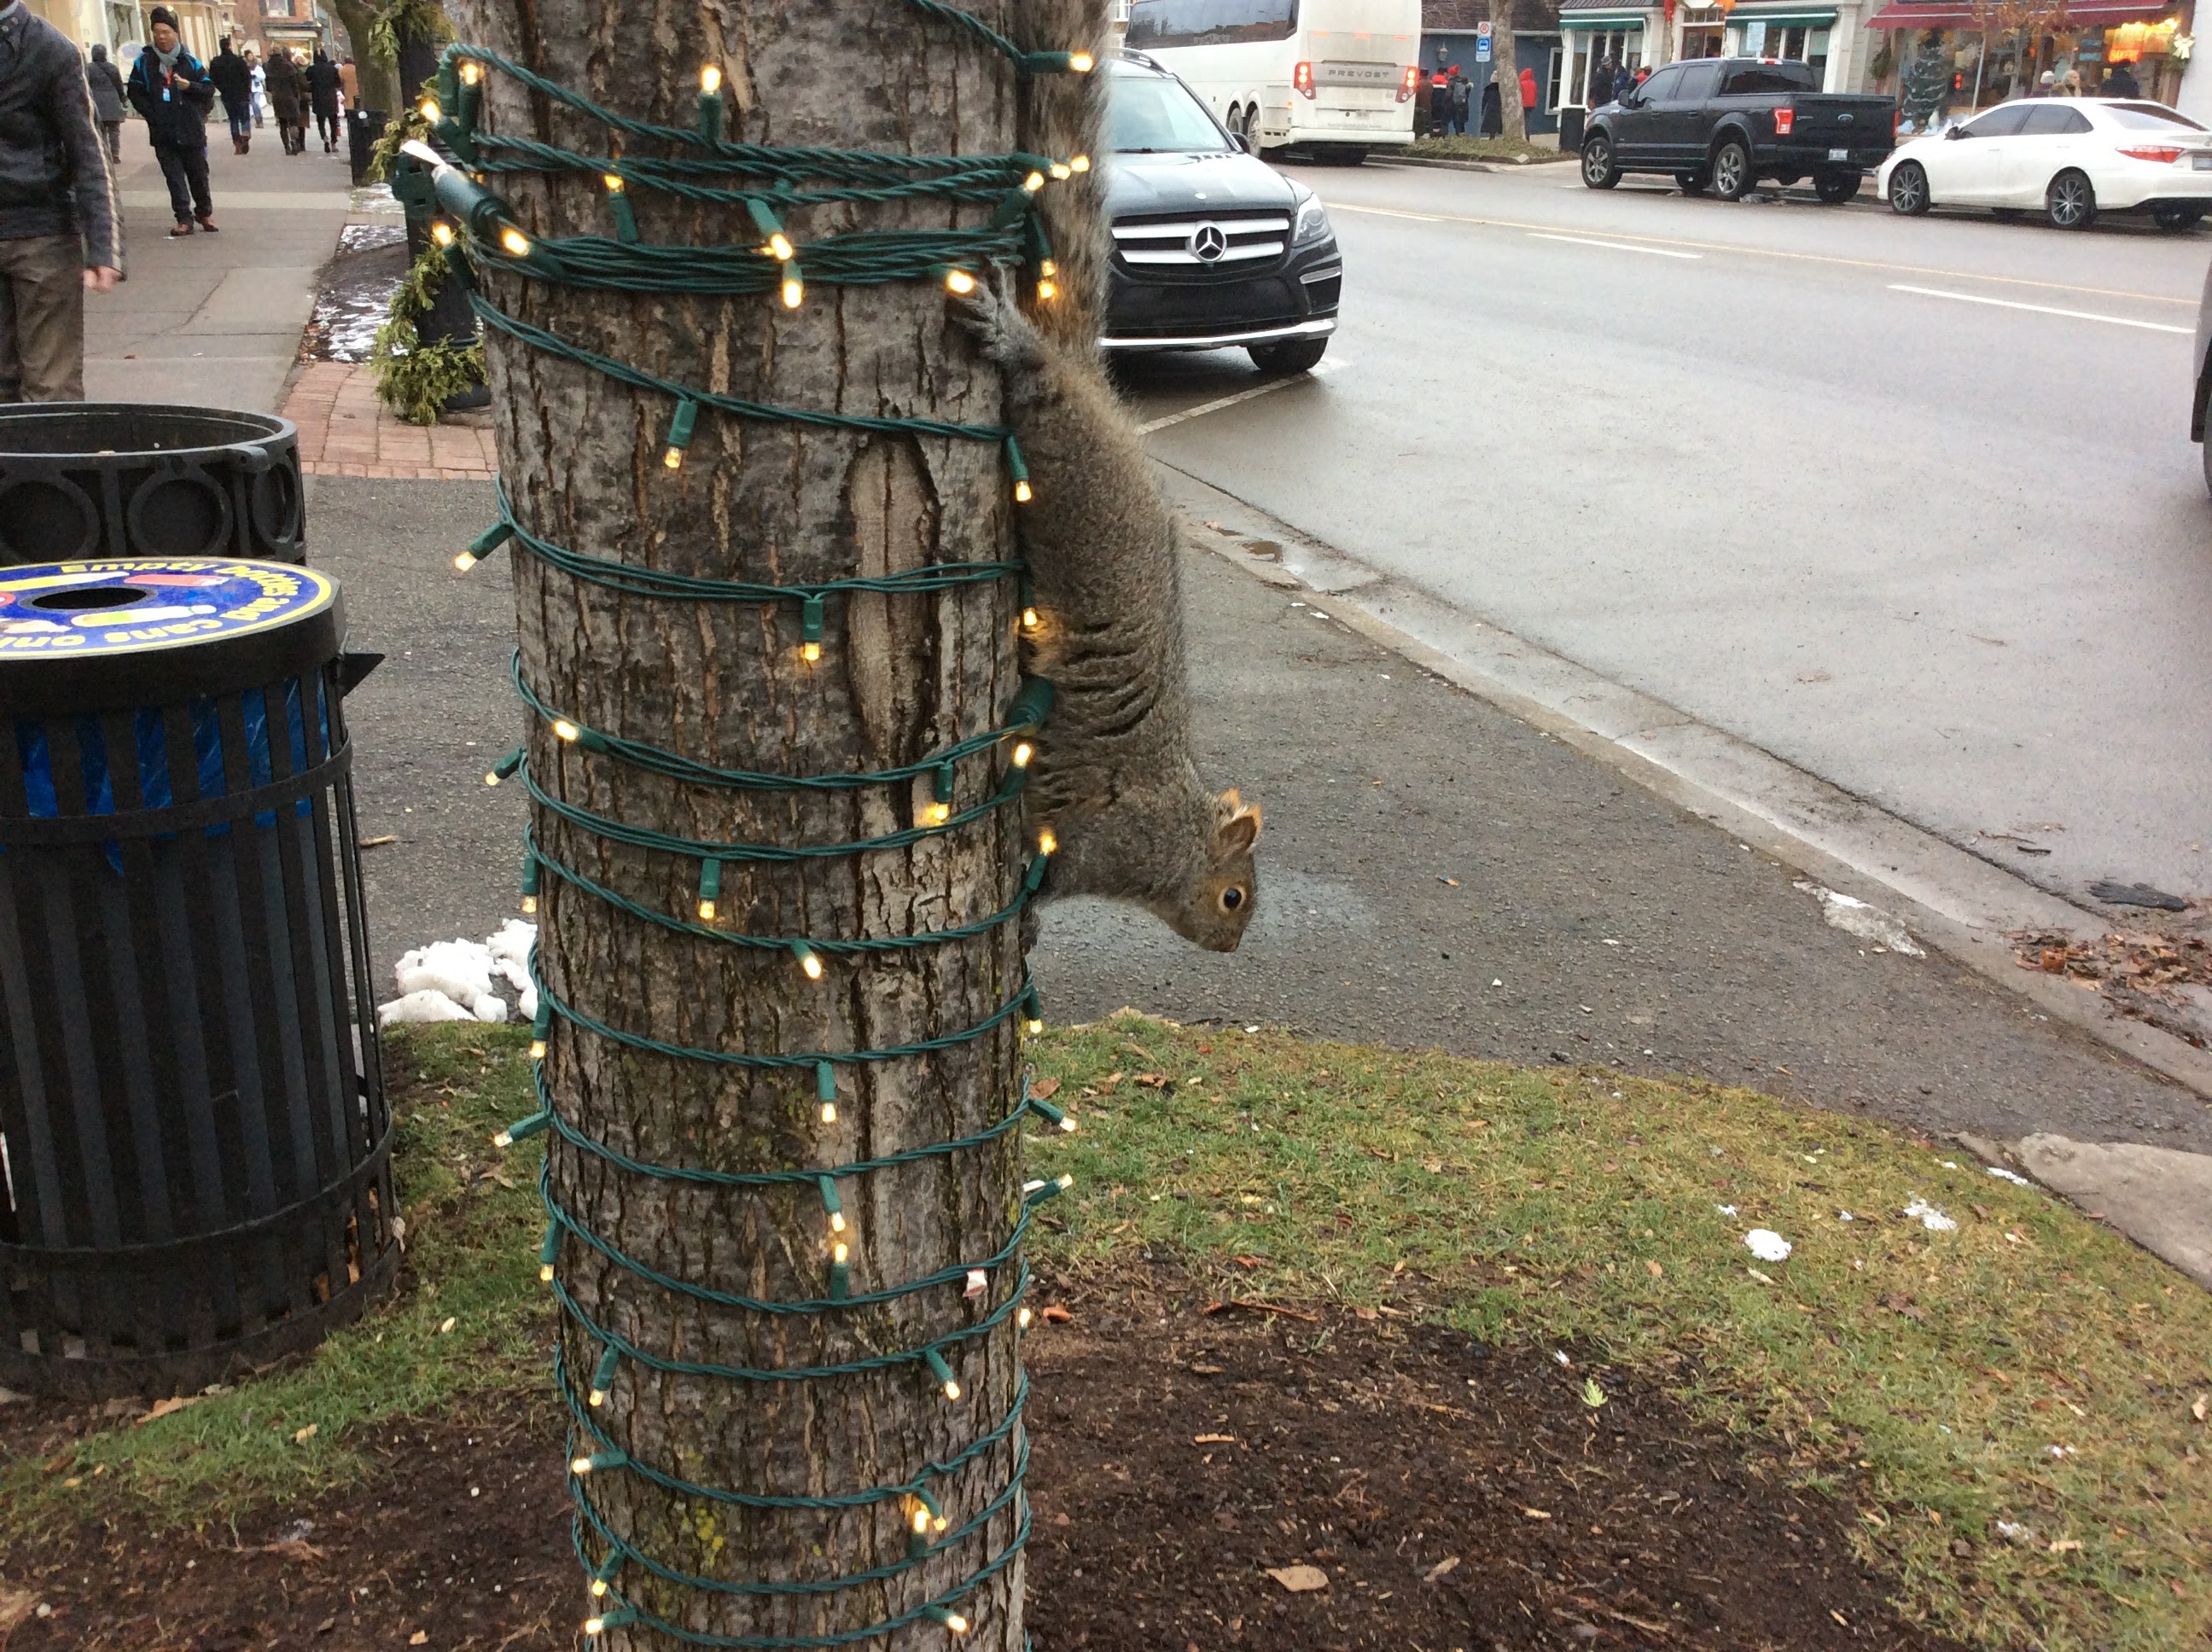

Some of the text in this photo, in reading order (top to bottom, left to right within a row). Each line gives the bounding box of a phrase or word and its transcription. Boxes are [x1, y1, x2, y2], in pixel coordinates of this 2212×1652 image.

[1329, 69, 1389, 78] PREVOST
[61, 561, 218, 573] Empty
[214, 565, 302, 596] bottles
[219, 597, 290, 621] and
